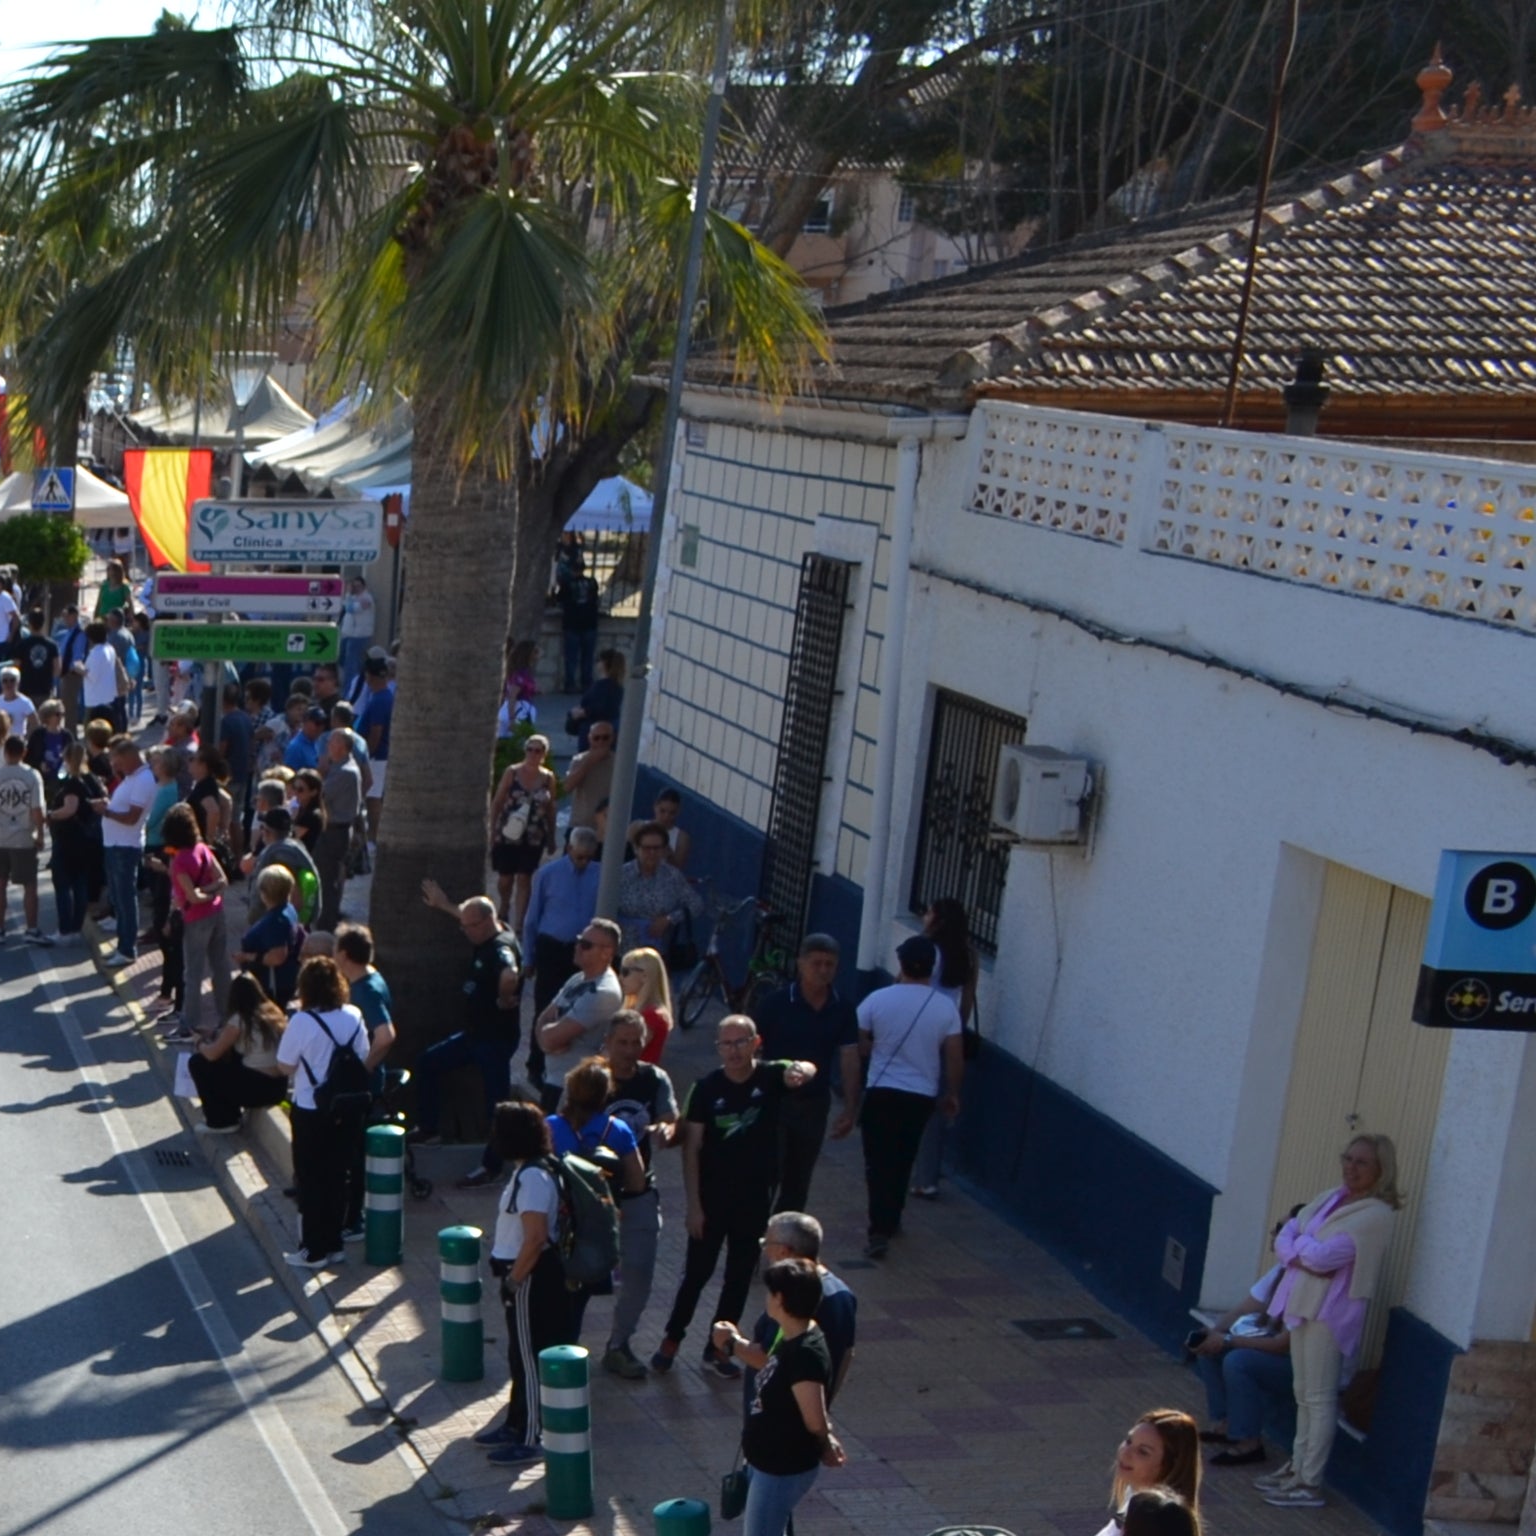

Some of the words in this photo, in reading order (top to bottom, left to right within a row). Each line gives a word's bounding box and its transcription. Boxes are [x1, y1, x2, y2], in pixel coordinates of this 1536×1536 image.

[164, 597, 205, 607] Guardia
[207, 597, 231, 607] Civil
[1482, 878, 1518, 915] B
[1494, 990, 1536, 1013] Ser
